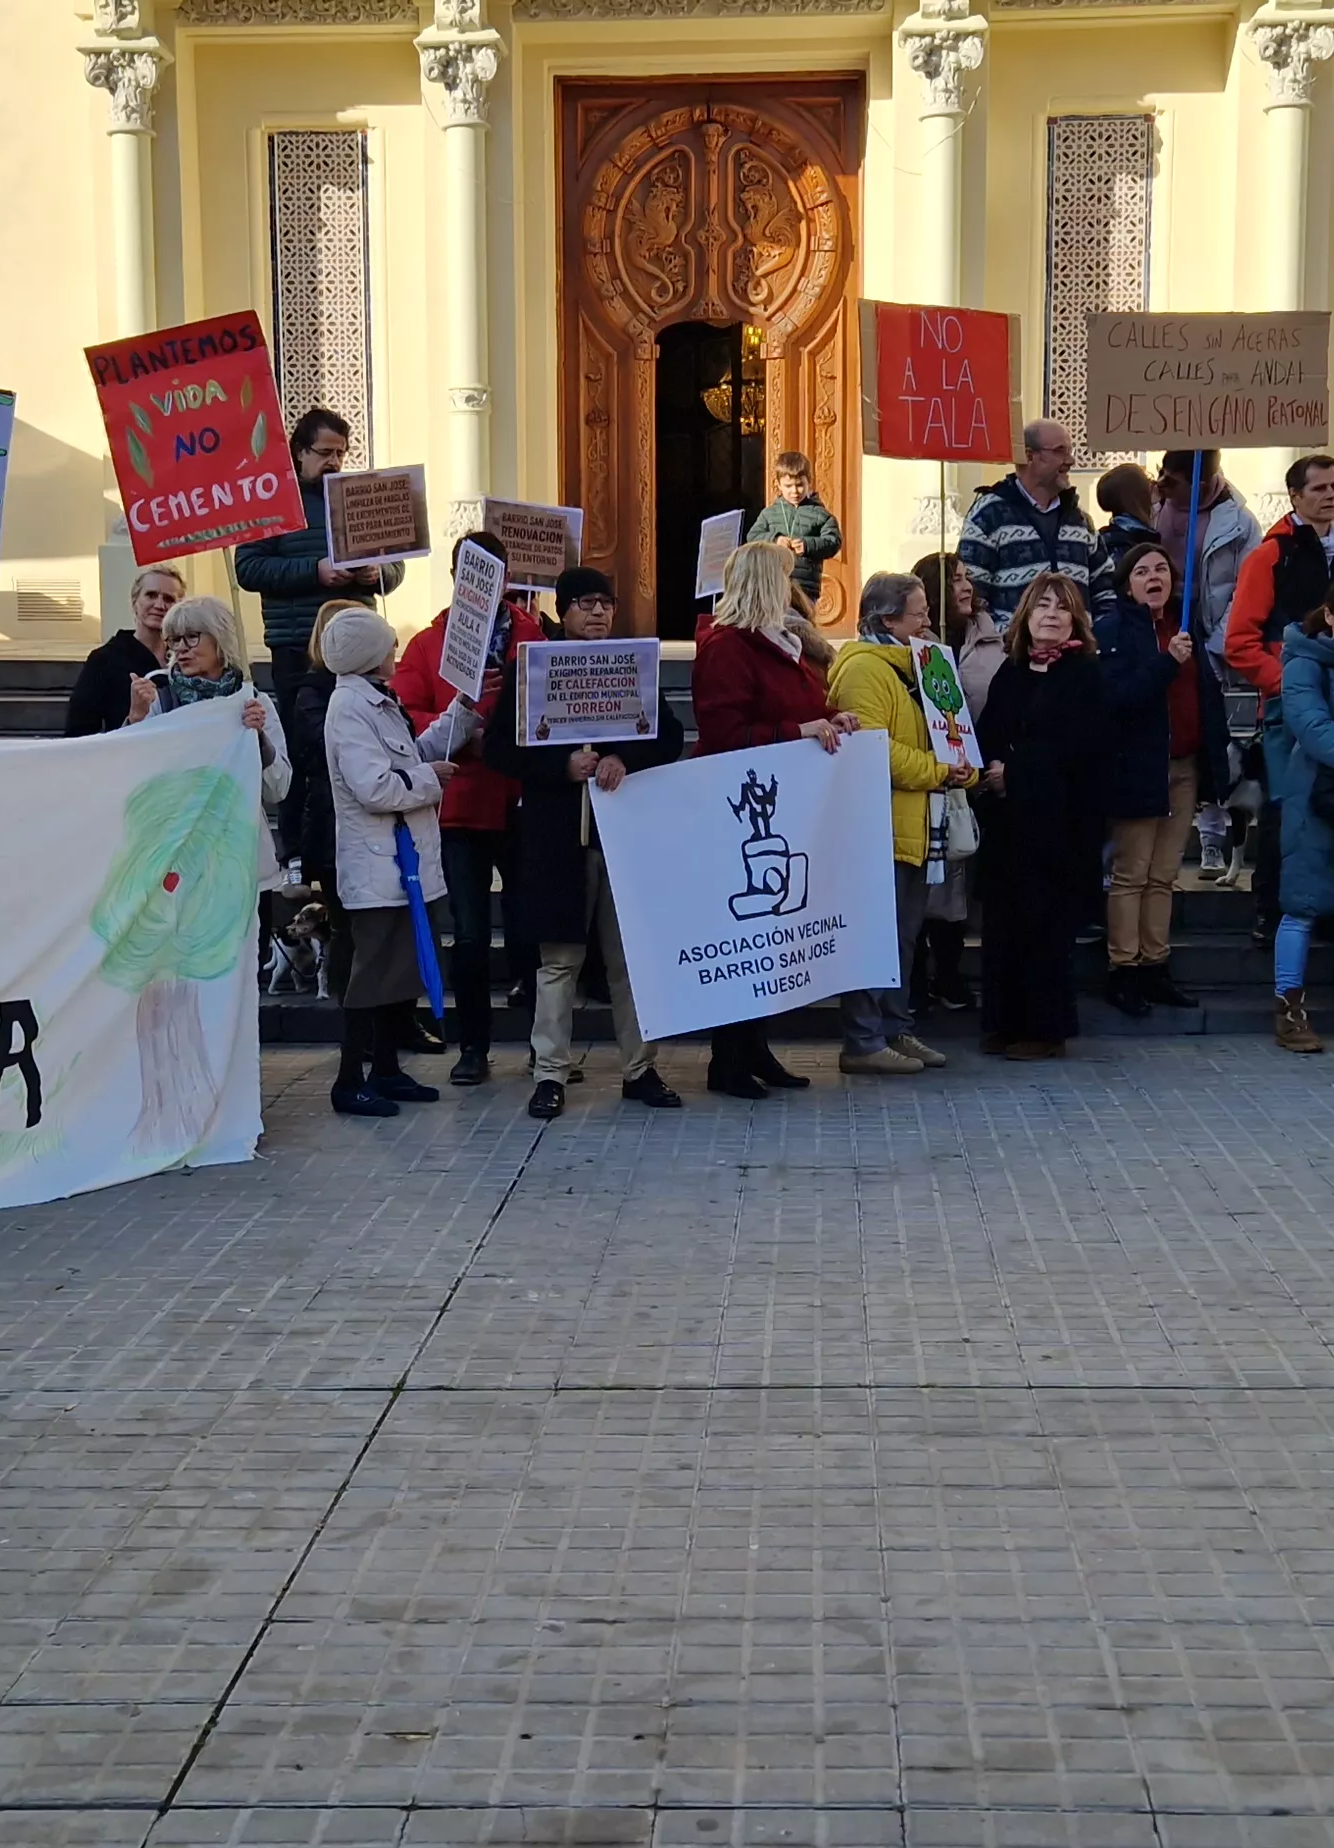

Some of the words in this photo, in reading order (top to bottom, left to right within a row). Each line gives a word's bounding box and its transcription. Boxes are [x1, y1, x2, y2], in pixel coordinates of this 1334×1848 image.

[921, 311, 963, 353] NO
[1108, 321, 1189, 352] CALLES
[1231, 323, 1303, 352] ACERAS
[93, 324, 257, 387] PLANTEMOS
[903, 357, 917, 391] A
[942, 358, 974, 394] LA
[1144, 357, 1215, 385] CALLES
[898, 396, 990, 451] TALA
[1106, 387, 1255, 437] DESENGAÑO
[175, 427, 221, 463] NO
[373, 482, 387, 493] SAN
[129, 472, 279, 534] CEMENTO
[460, 567, 475, 586] SAN
[464, 550, 495, 579] BARRIO
[549, 668, 588, 678] EXIGIMOS
[551, 656, 587, 667] BARRIO
[589, 654, 609, 665] SAN
[611, 653, 635, 664] JOSÉ
[547, 693, 557, 702] EN
[559, 692, 568, 701] EL
[570, 691, 599, 701] EDIFICIO
[601, 689, 639, 699] MUNICIPAL
[551, 680, 563, 690] DE
[566, 698, 621, 714] TORREÓN
[932, 720, 939, 730] A
[678, 926, 794, 965] ASOCIACIÓN
[798, 914, 847, 940] VECINAL
[698, 956, 774, 984] BARRIO
[780, 949, 806, 968] SAN
[808, 935, 836, 961] JOSÉ
[753, 971, 811, 998] HUESCA
